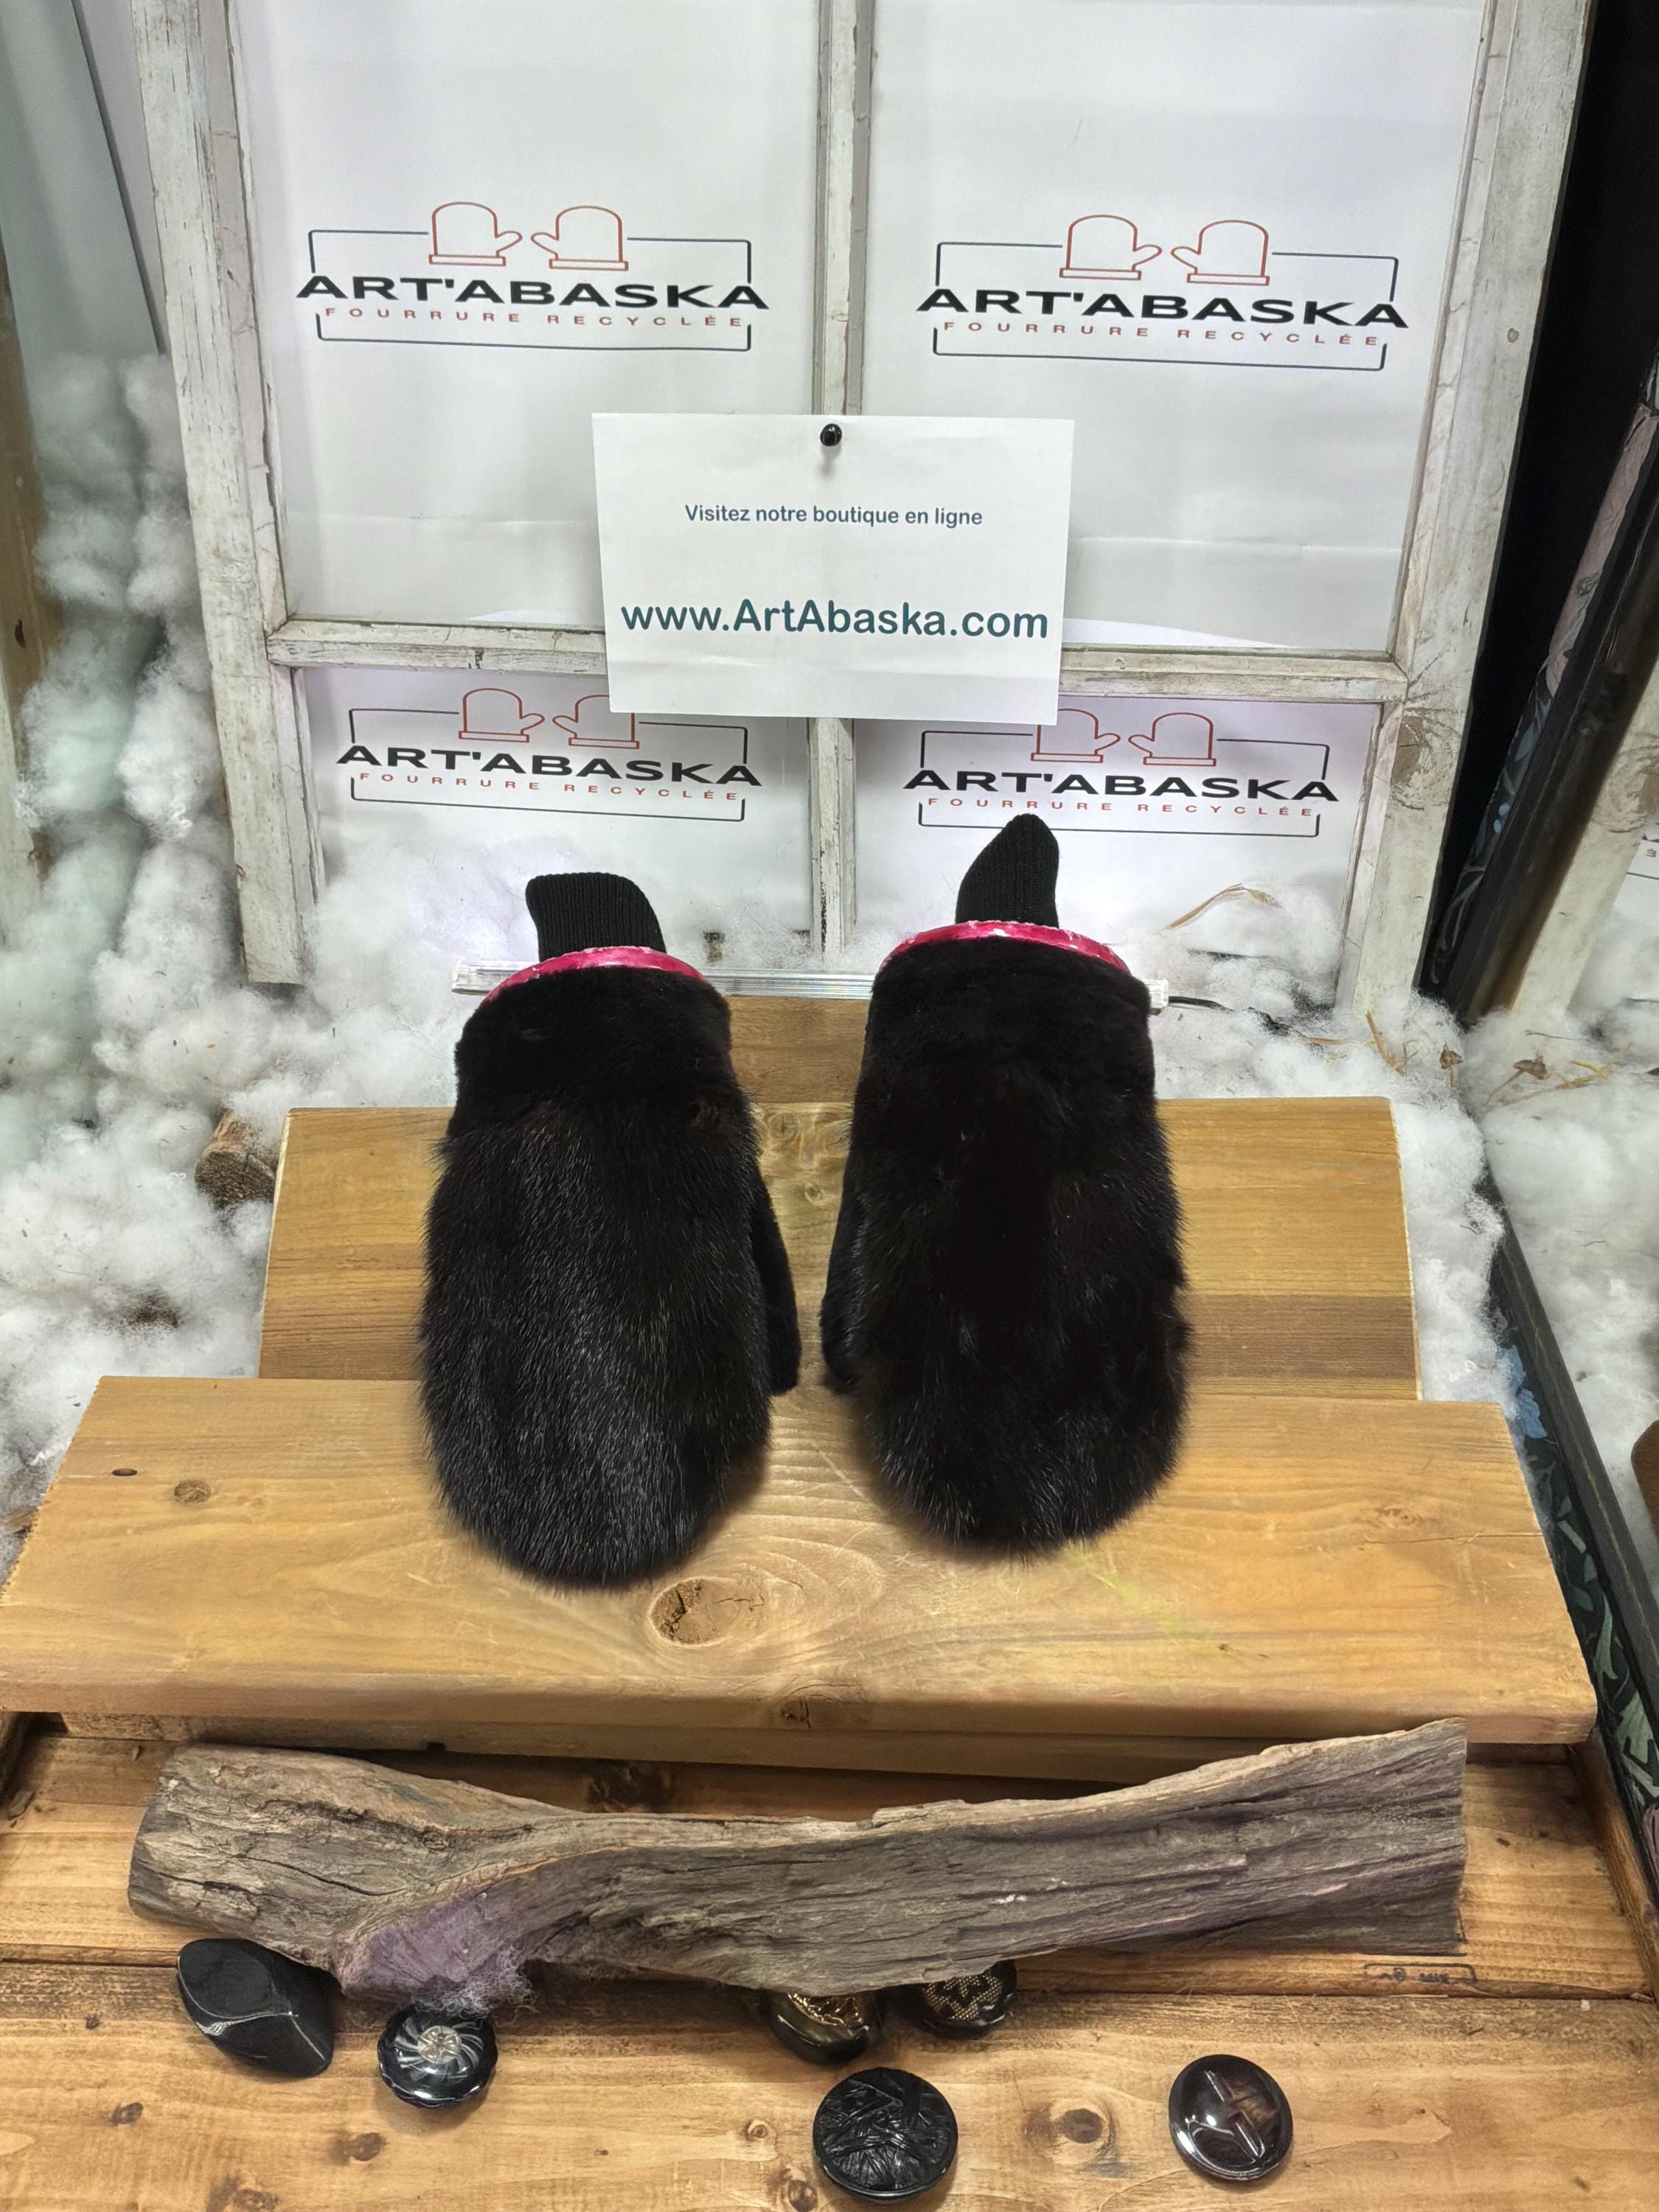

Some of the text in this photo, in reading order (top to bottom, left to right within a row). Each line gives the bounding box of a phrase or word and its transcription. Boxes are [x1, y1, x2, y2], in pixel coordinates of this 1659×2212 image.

[296, 275, 770, 310] ART'ABASKA
[326, 307, 741, 327] FOURRURE RECYCLÉE
[916, 288, 1408, 328] ART'ABASKA
[944, 321, 1377, 346] FOURRURE RECYCLÉE
[685, 504, 983, 528] Visitez notre boutique en ligne
[620, 599, 1048, 639] www.ArtAbaska.com
[335, 745, 762, 787] ART'ABASKA
[360, 773, 737, 800] FOURRURE RECYCLÉE
[902, 770, 1339, 802] ART'ABASKA
[928, 798, 1312, 817] FOURRURE RECYCLÉE
